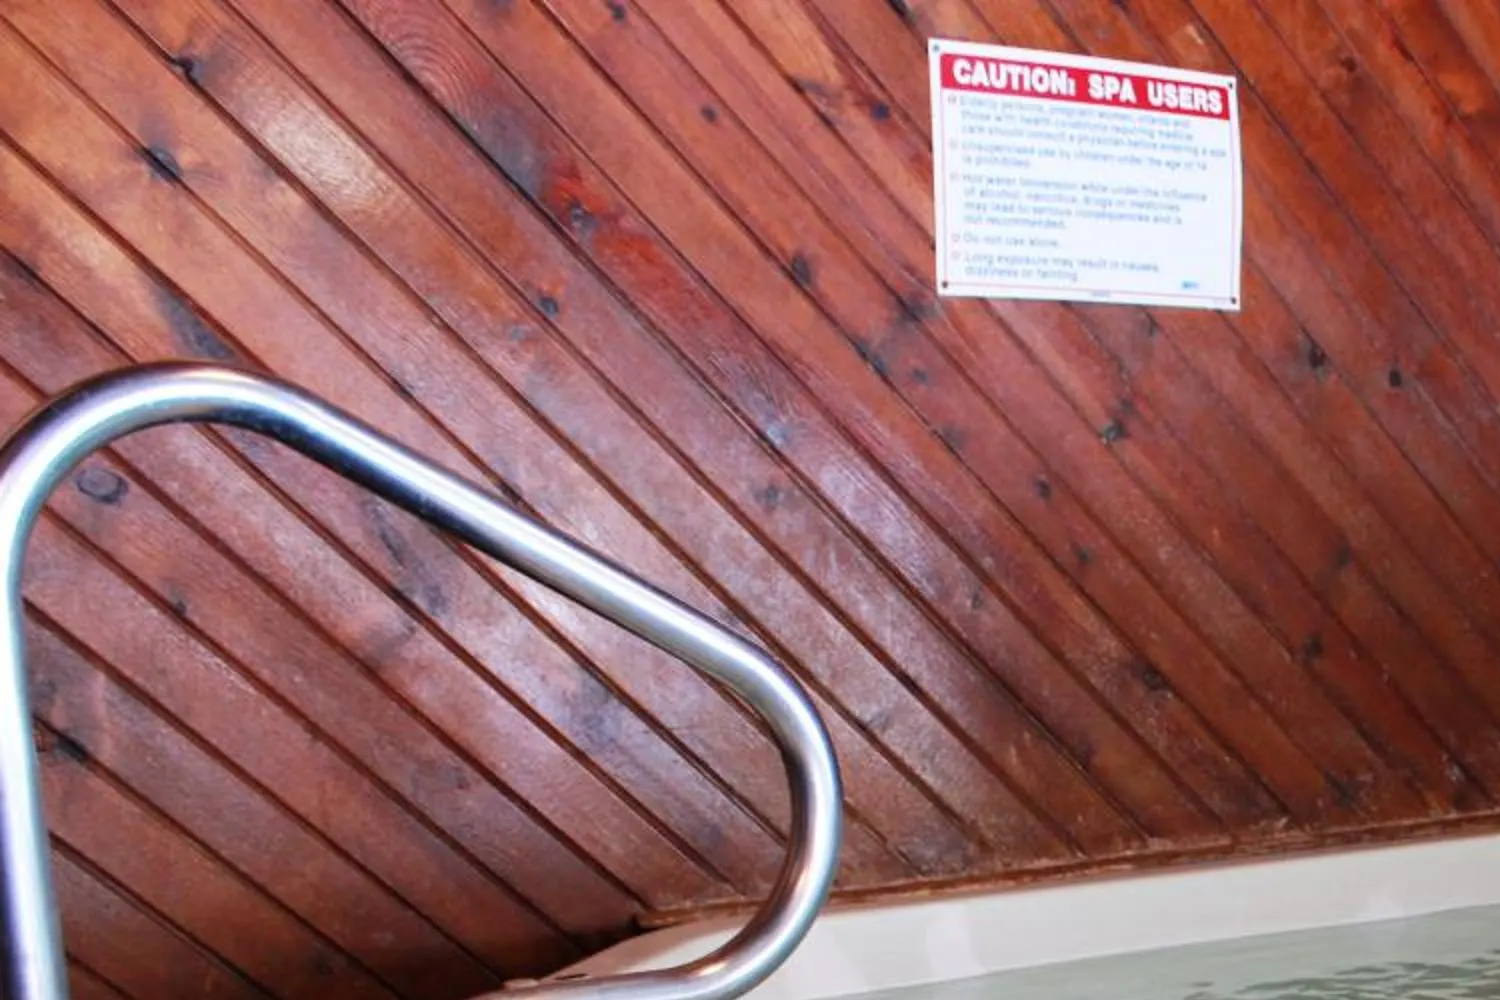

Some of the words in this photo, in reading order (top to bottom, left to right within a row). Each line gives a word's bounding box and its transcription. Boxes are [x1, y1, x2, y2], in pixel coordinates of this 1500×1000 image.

[953, 59, 1076, 95] CAUTION:
[1087, 73, 1137, 103] SPA
[1147, 80, 1223, 114] USERS
